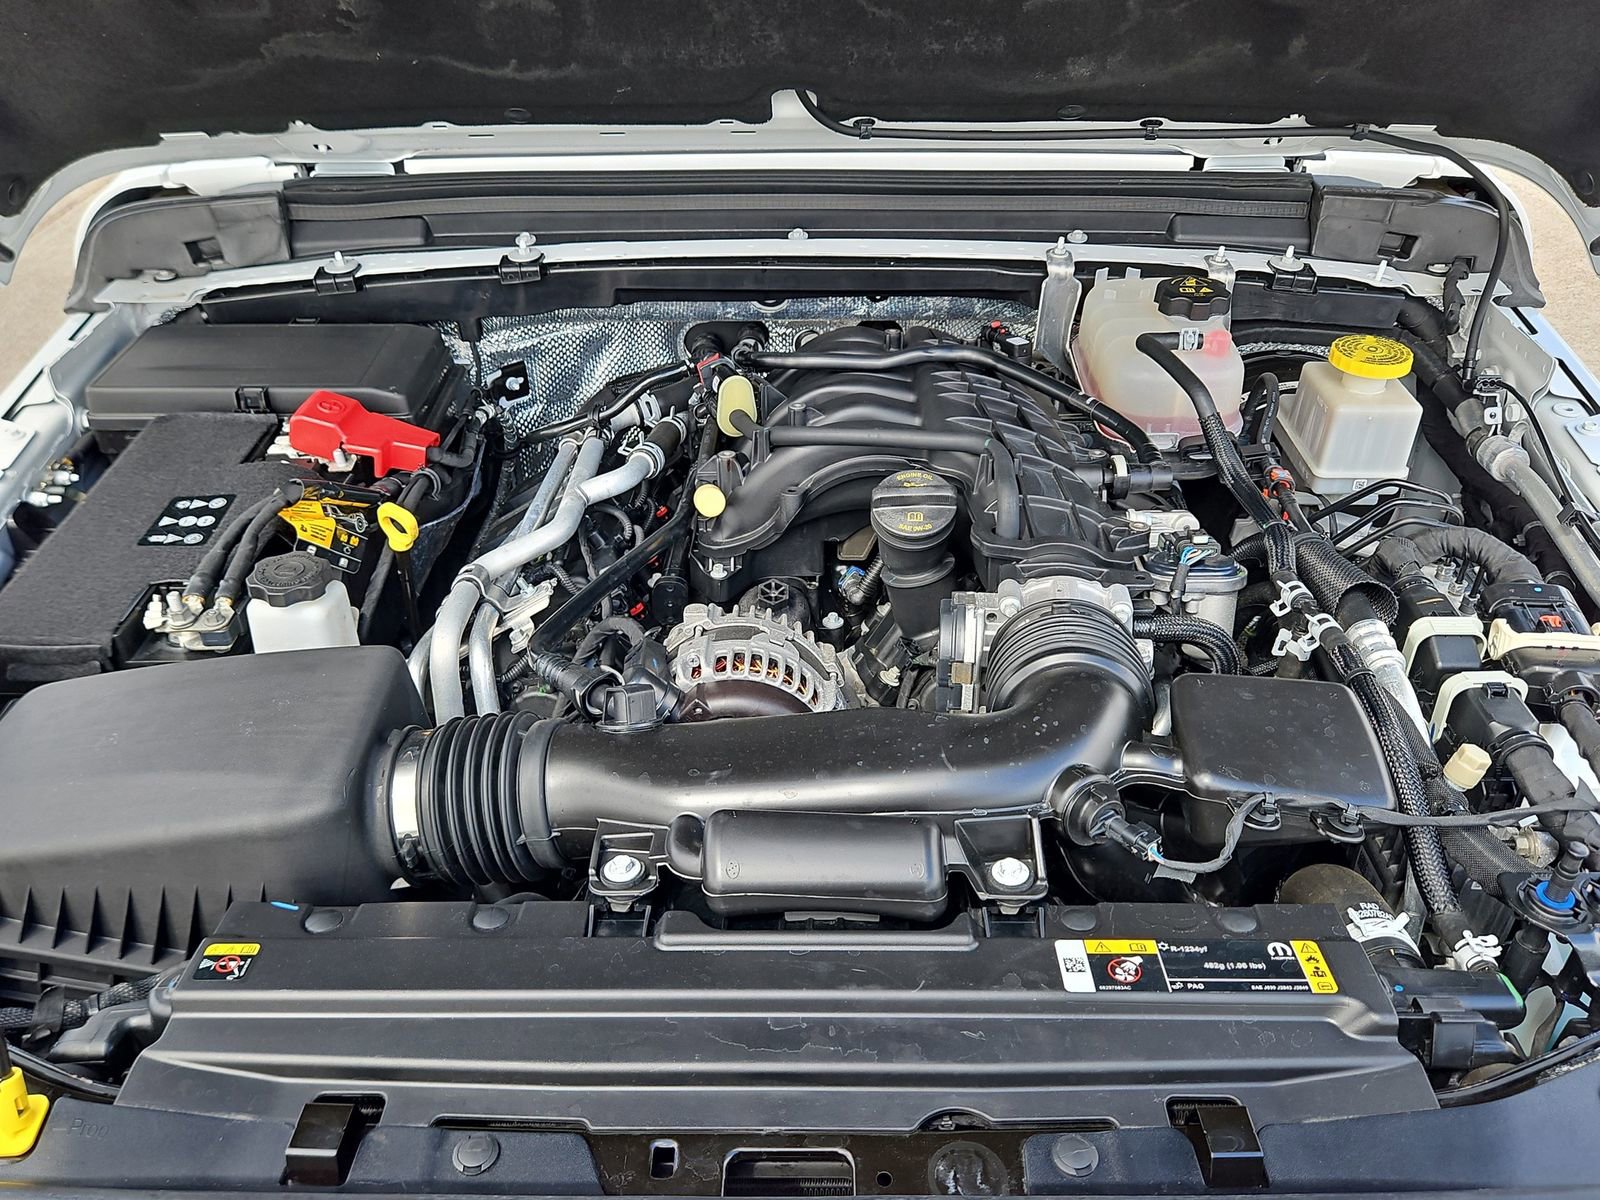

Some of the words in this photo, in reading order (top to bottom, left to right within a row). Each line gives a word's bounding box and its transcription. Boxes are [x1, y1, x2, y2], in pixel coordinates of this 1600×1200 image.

[896, 472, 922, 481] ENGINE
[923, 473, 933, 481] OIL
[1359, 902, 1380, 910] RAD
[1249, 961, 1267, 971] lbs)
